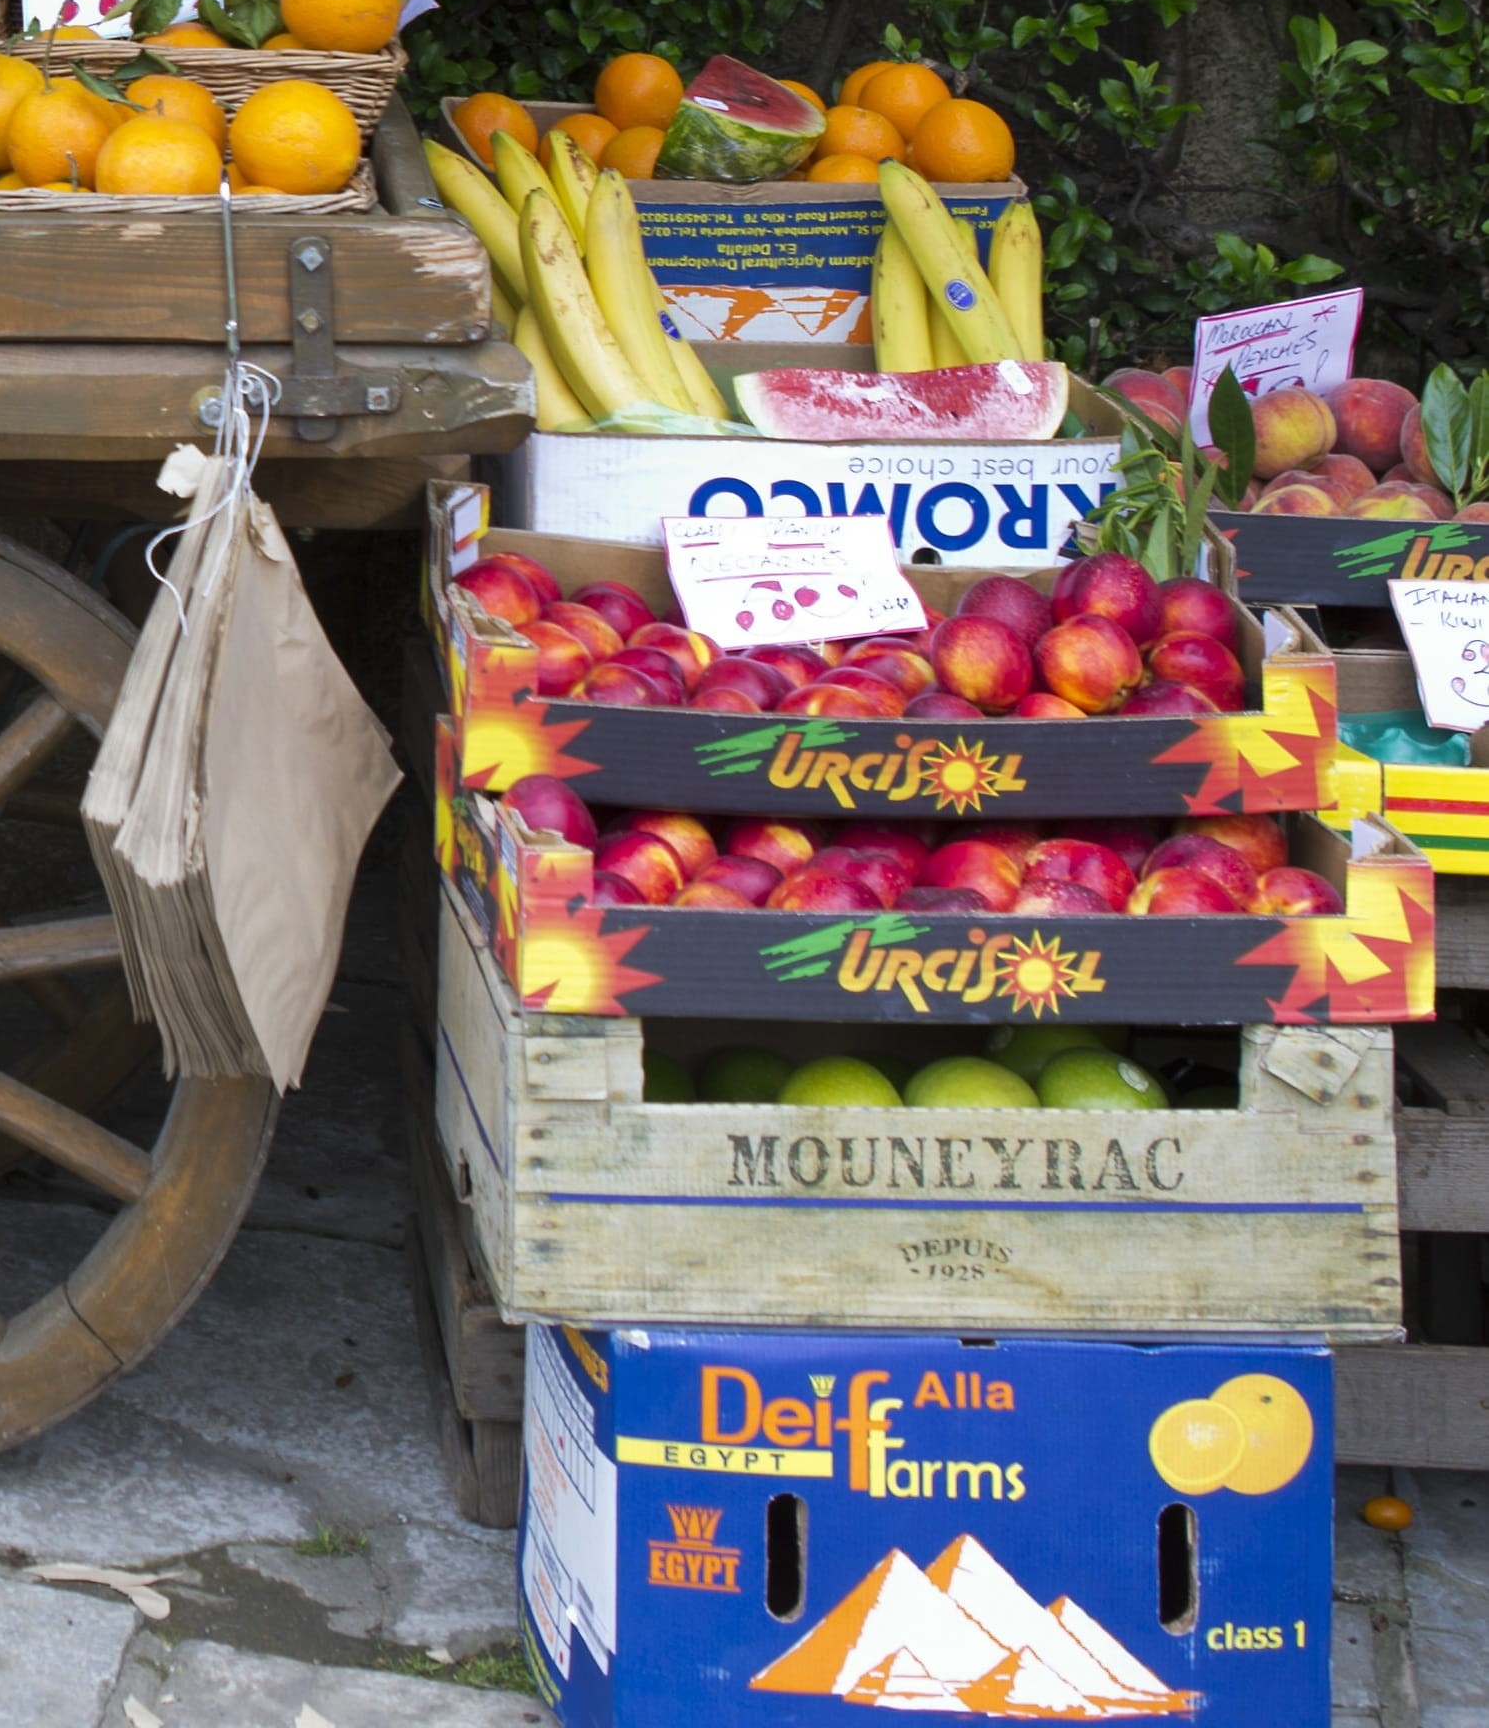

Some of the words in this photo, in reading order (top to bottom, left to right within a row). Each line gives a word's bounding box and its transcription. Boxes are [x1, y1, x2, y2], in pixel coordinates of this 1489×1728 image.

[795, 211, 827, 222] Road
[742, 253, 823, 270] Agricultural
[848, 456, 955, 479] choice
[972, 458, 1034, 480] best
[1440, 611, 1483, 629] KIWI
[727, 1133, 1186, 1194] MOUNEYRAC
[898, 1237, 1014, 1265] DEPUIS
[914, 1369, 1015, 1410] Alla
[663, 1445, 787, 1472] EGYPT
[648, 1546, 741, 1588] EGYPT
[1206, 1621, 1284, 1651] class
[1291, 1621, 1307, 1649] 1
